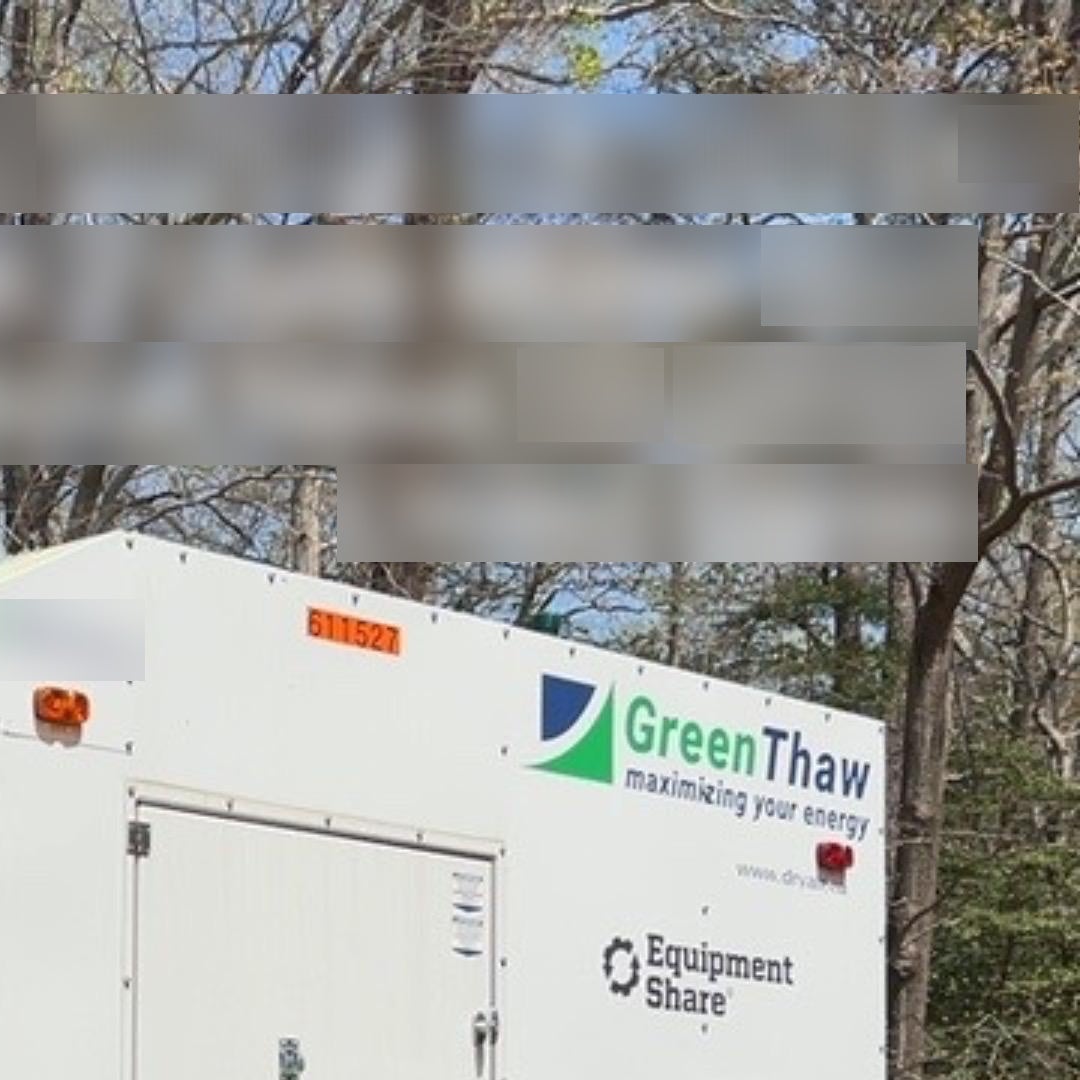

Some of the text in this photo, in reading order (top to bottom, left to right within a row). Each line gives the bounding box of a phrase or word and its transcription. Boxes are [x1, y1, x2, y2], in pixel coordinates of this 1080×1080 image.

[308, 607, 399, 655] 611527
[625, 695, 871, 799] GreenThaw
[624, 767, 870, 842] maximizing your energy
[646, 933, 794, 985] Equipment
[646, 975, 727, 1016] Share
